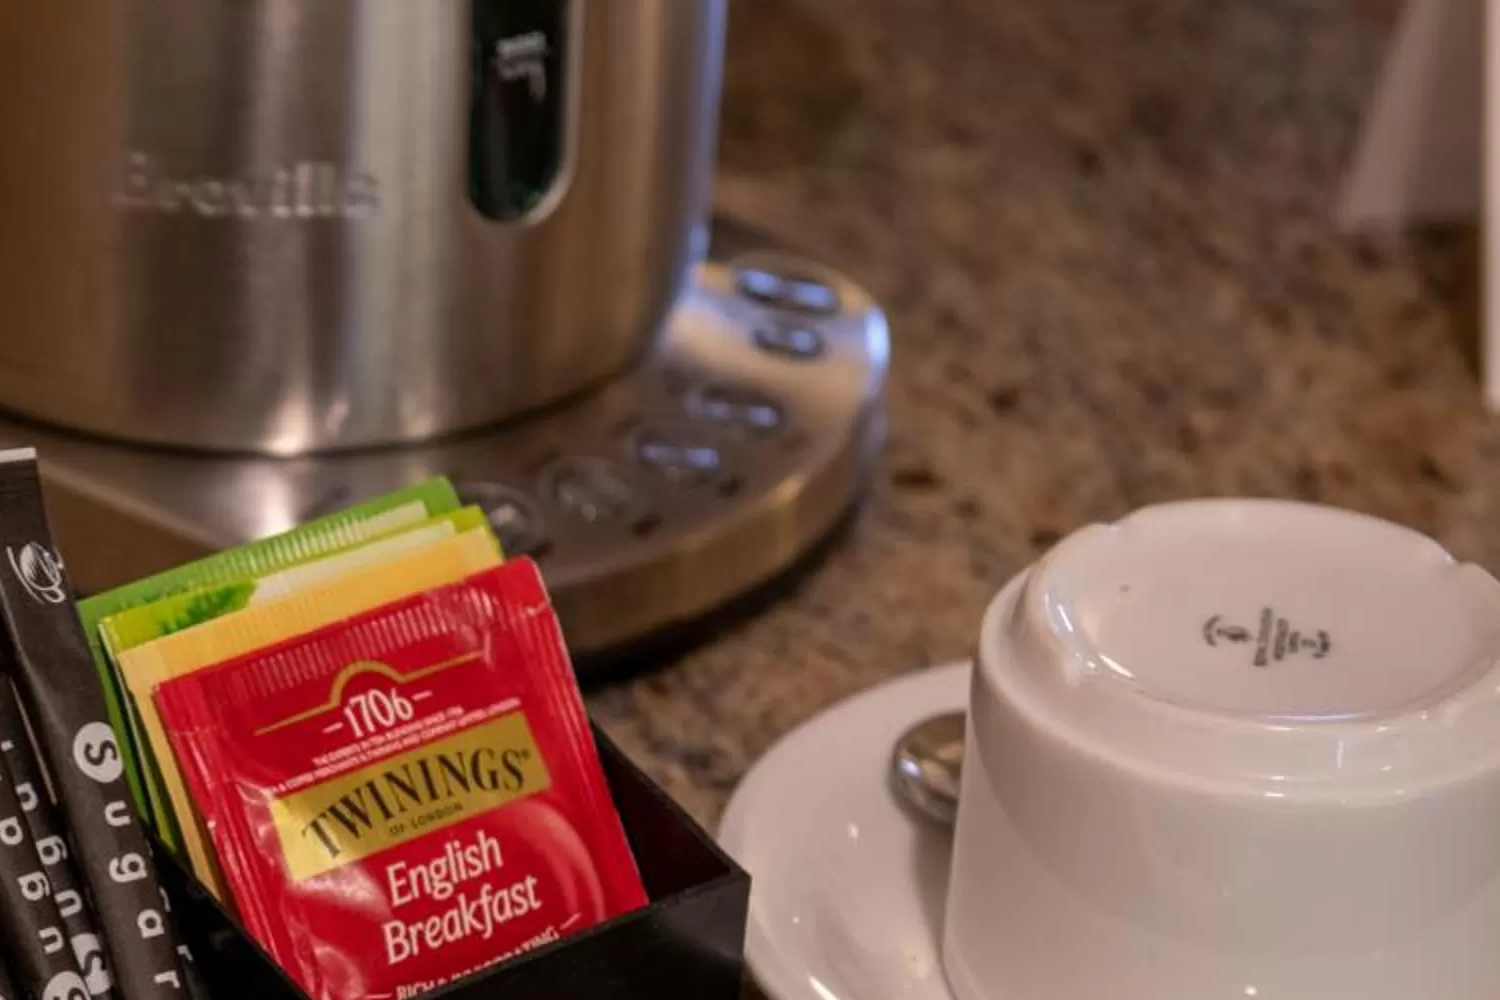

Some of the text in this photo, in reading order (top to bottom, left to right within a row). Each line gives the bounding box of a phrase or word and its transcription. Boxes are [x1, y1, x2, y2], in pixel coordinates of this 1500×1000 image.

[345, 688, 414, 738] 1706
[73, 722, 181, 992] Sugar
[387, 831, 502, 907] English
[381, 874, 543, 965] Breakfast
